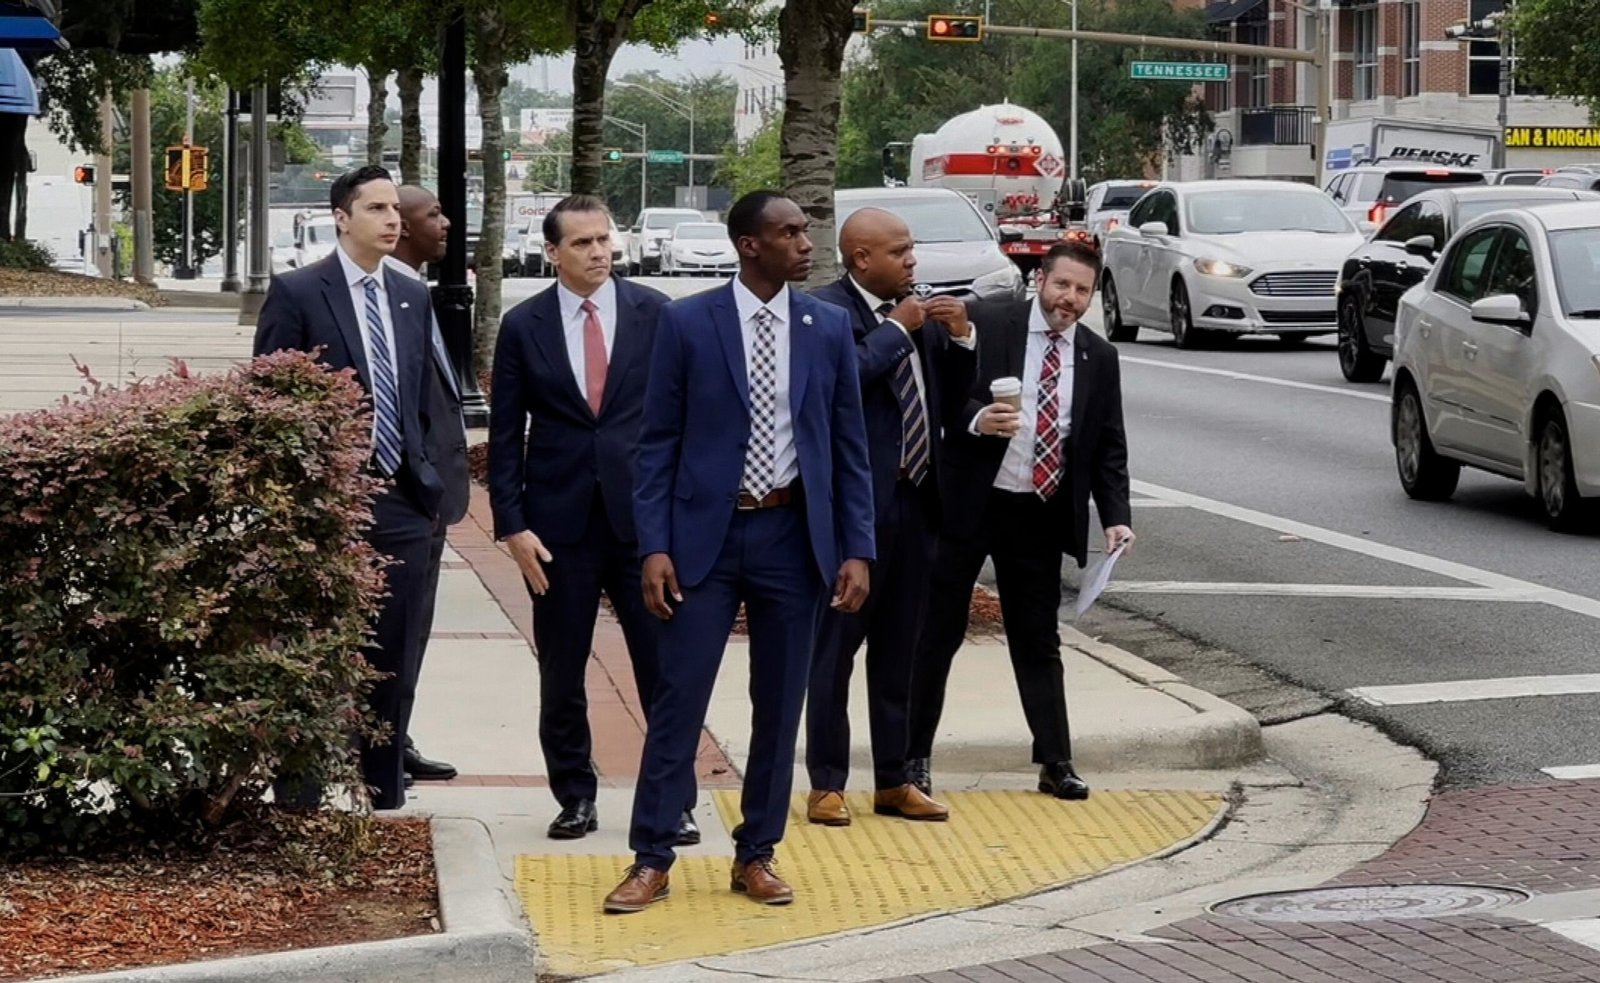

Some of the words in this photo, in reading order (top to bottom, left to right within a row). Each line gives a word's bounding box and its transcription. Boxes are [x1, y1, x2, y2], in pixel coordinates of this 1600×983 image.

[1137, 64, 1222, 77] TENNESSEE
[1534, 128, 1543, 146] &
[1546, 128, 1600, 146] MORGAN
[1390, 146, 1480, 167] PENSKE
